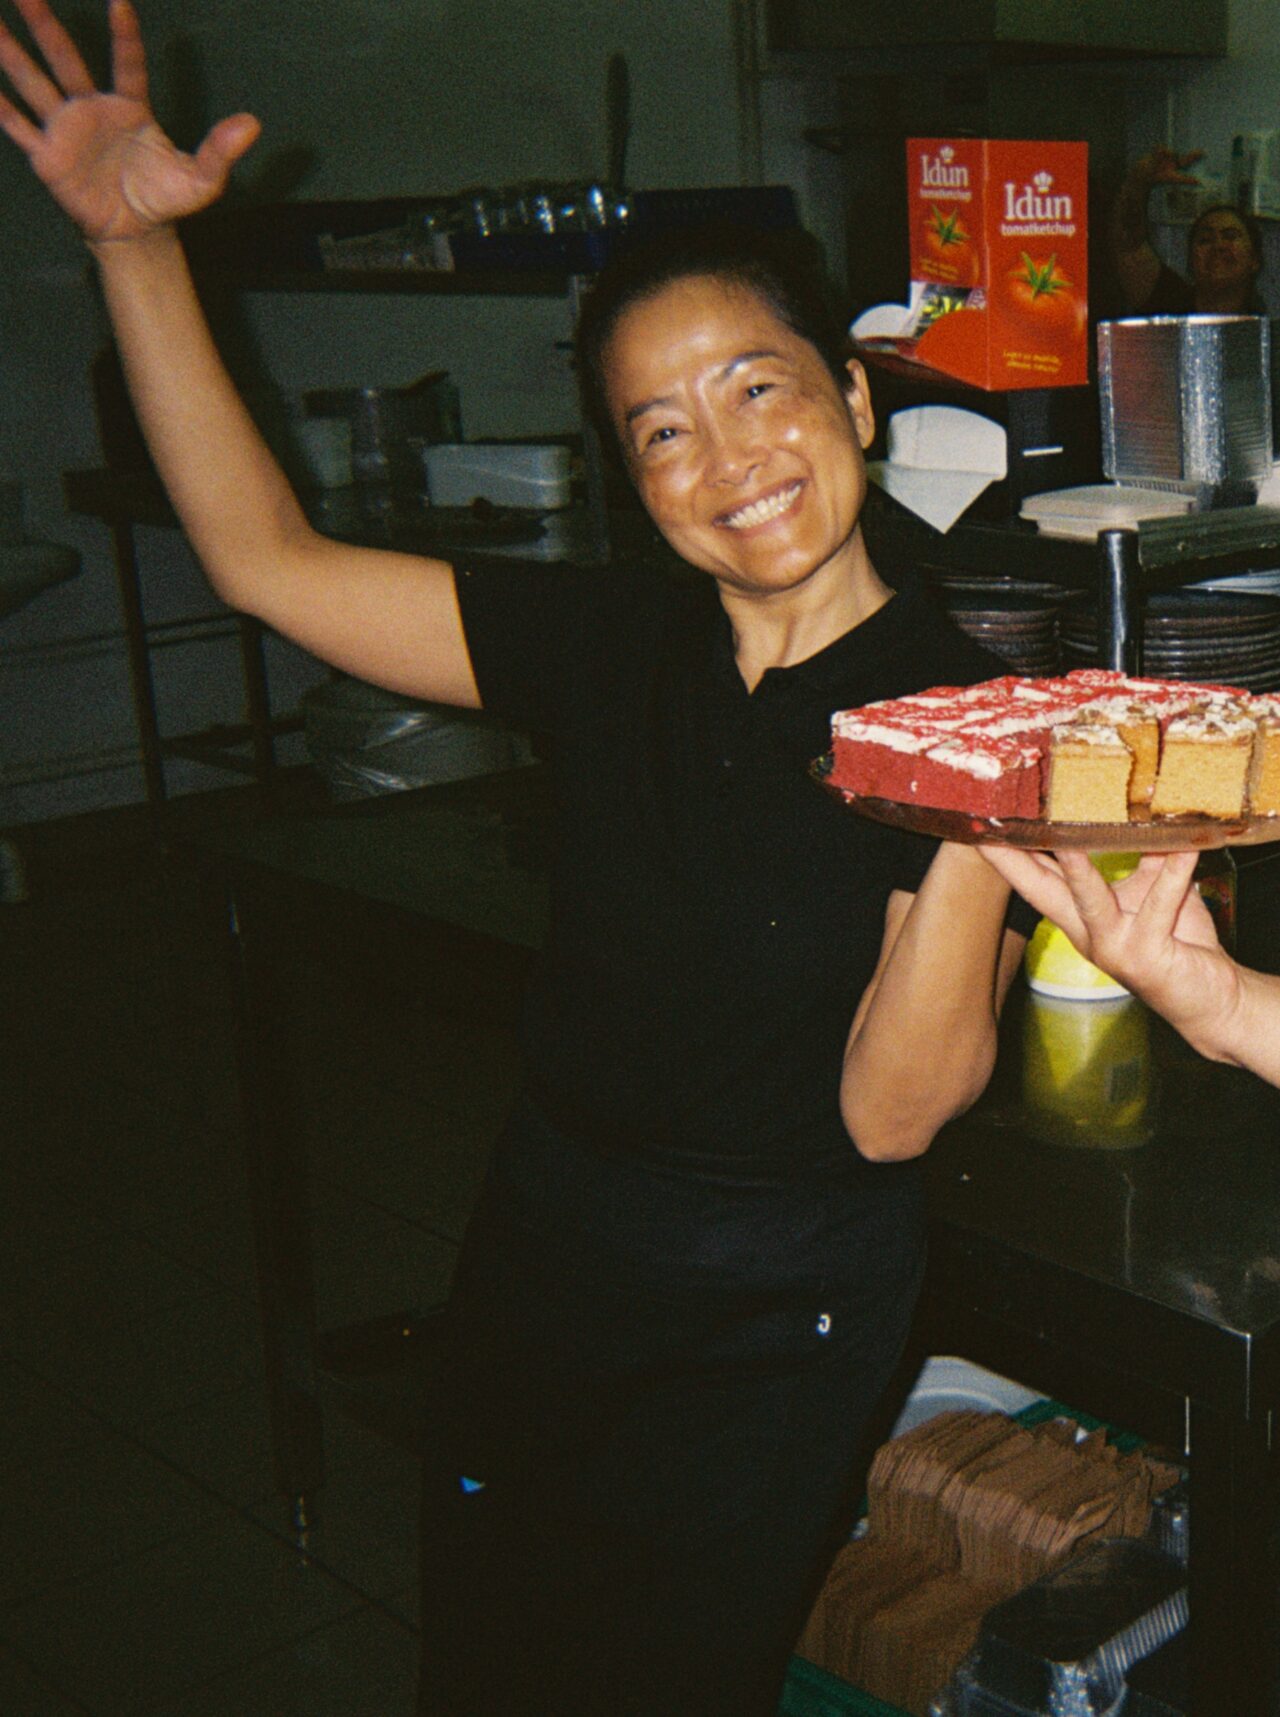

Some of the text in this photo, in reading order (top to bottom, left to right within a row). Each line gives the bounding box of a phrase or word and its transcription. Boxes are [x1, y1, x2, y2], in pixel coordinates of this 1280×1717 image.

[920, 154, 969, 187] Idun
[1004, 183, 1073, 220] Idun
[1000, 222, 1076, 238] tomatketchup
